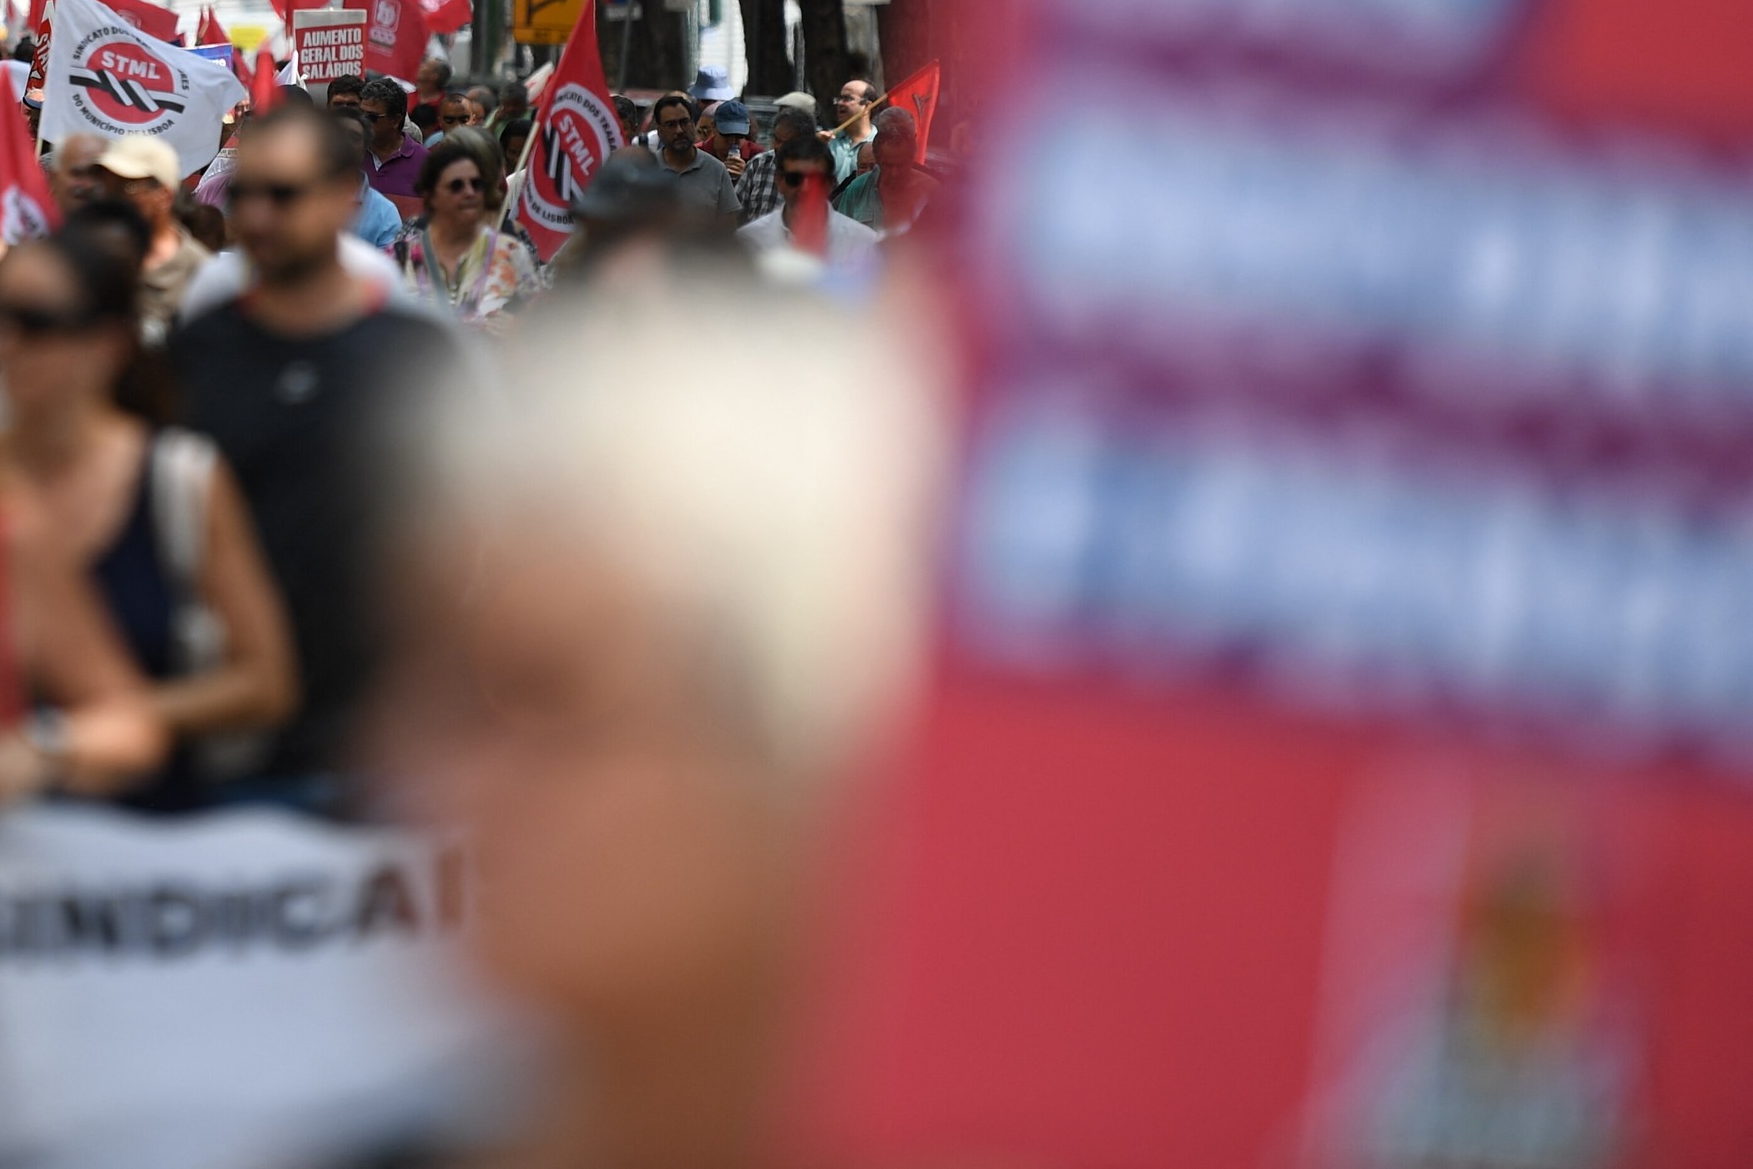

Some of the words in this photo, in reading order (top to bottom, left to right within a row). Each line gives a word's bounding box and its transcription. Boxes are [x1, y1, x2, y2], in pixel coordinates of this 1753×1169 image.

[303, 27, 362, 48] AUMENTO
[101, 50, 161, 80] STML
[300, 46, 339, 65] GERAL
[339, 43, 364, 61] DOS
[302, 60, 362, 80] SALÁRIOS
[559, 115, 596, 177] STML
